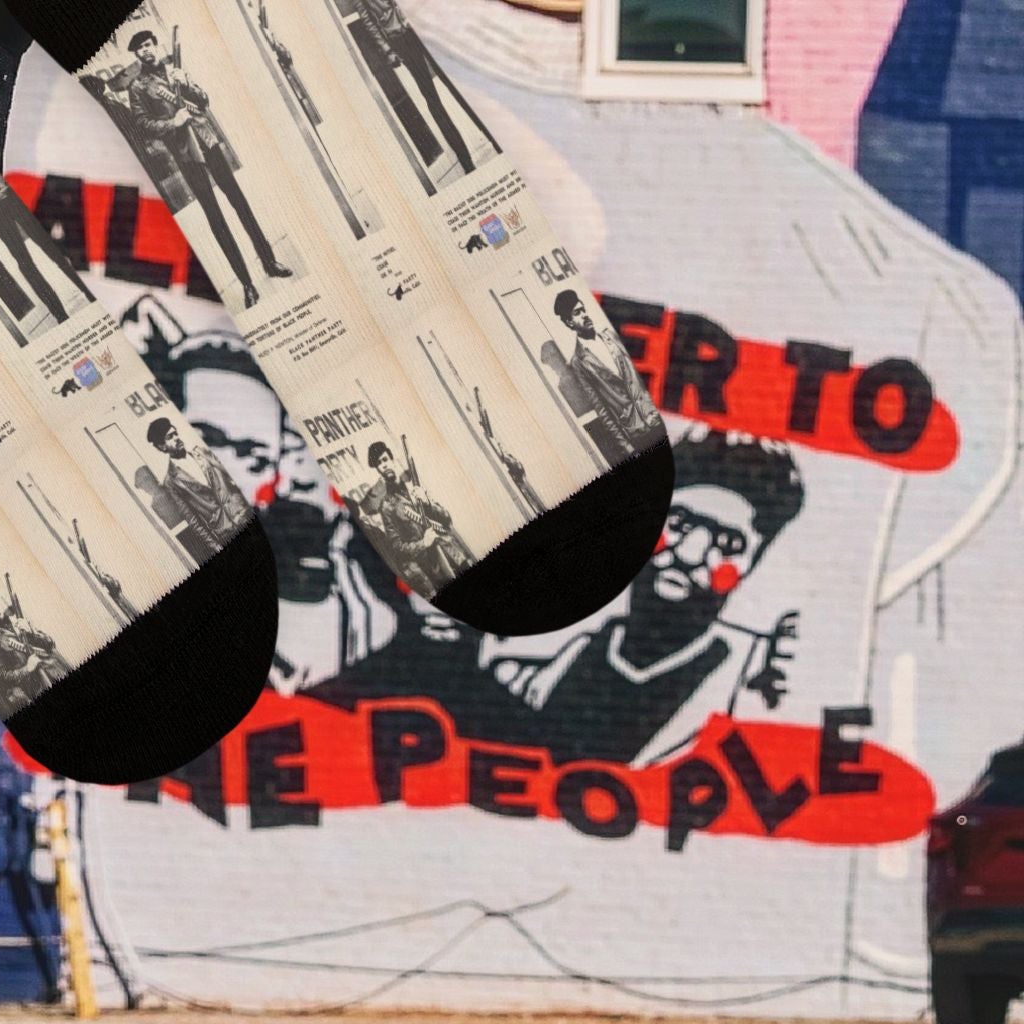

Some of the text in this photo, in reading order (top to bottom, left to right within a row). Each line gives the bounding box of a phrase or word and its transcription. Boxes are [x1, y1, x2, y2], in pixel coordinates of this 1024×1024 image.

[303, 401, 377, 447] PANTHER
[785, 339, 933, 454] TO
[371, 707, 881, 853] PEOPLE
